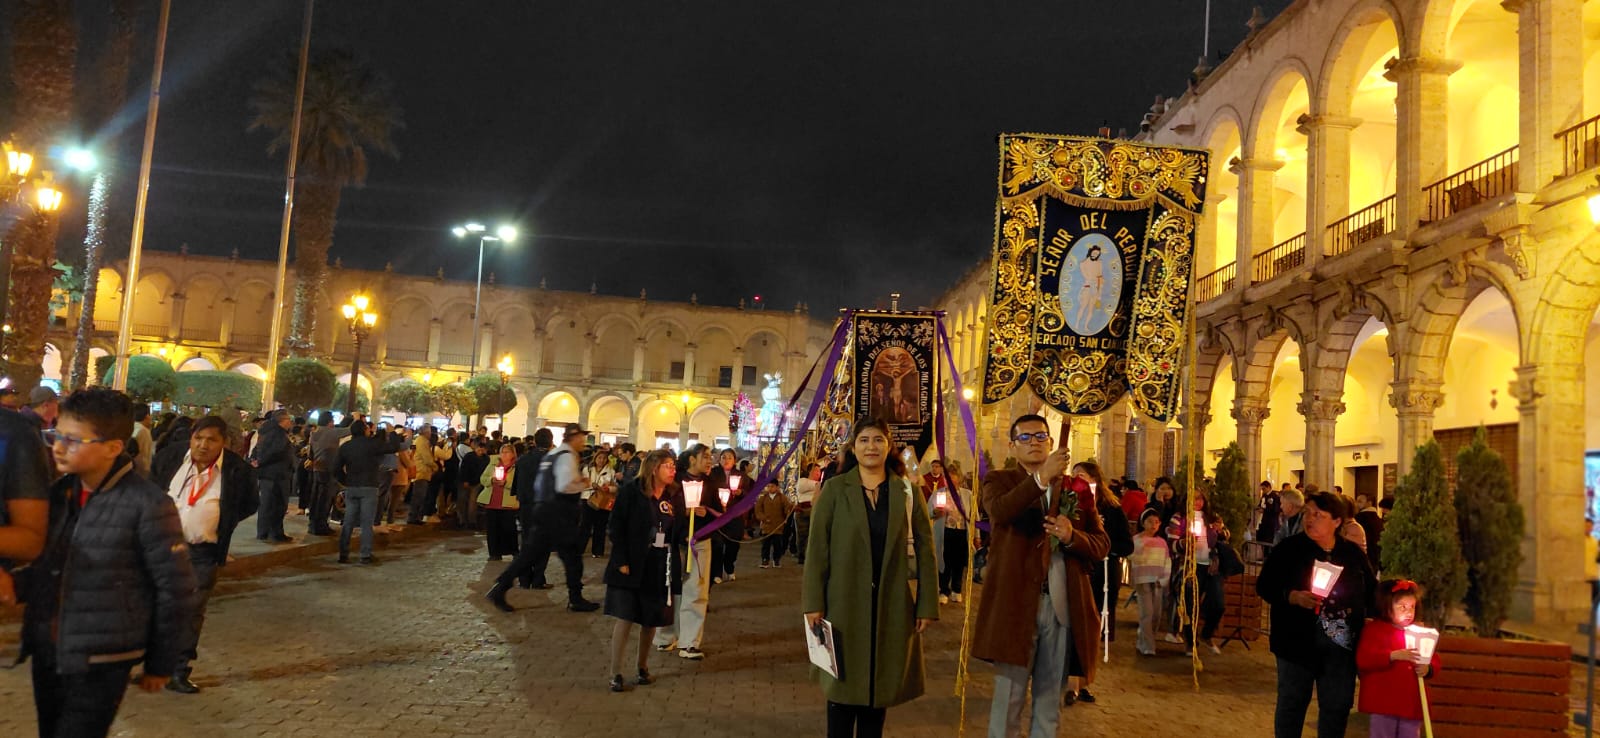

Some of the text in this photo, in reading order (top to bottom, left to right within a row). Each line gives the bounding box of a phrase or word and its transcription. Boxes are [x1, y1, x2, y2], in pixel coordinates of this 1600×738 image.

[1080, 212, 1107, 231] DEL
[1036, 333, 1076, 346] ERCADO
[1079, 336, 1099, 348] SAN
[860, 339, 929, 412] HERMANDAD DEL SEÑOR DE LOS MILAGROS
